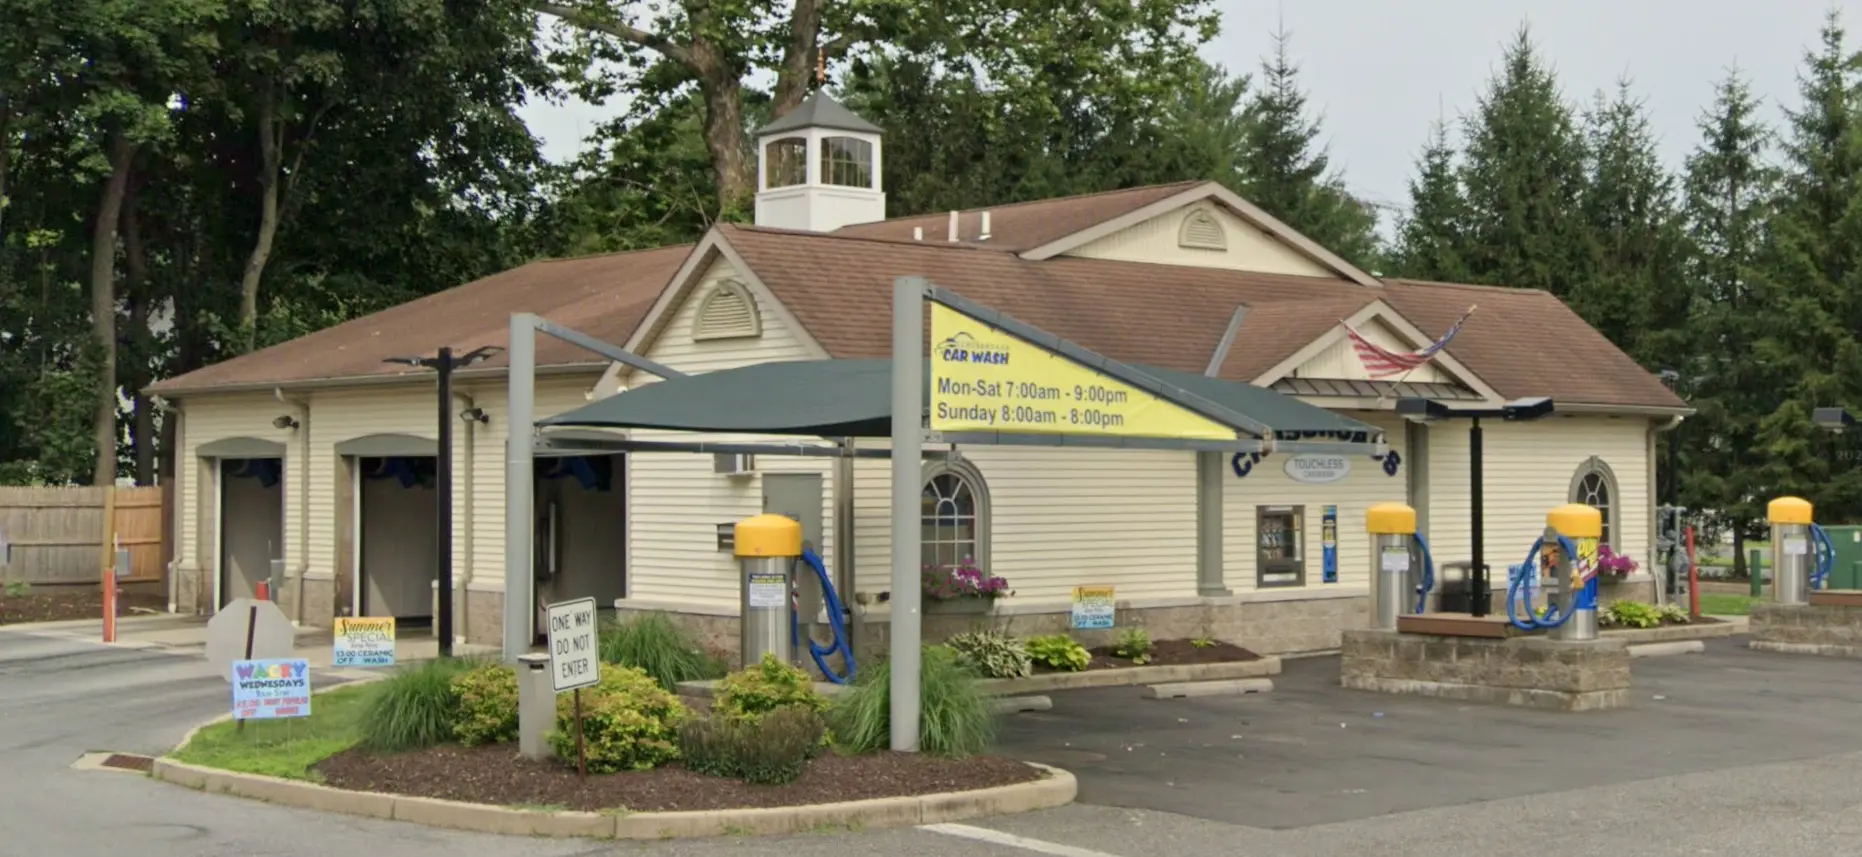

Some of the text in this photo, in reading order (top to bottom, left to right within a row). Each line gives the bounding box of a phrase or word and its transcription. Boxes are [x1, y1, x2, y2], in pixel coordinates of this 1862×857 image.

[943, 348, 1009, 365] CAR WASH
[938, 376, 1001, 397] Mon-Sat
[1006, 381, 1060, 399] 7:00am
[1074, 385, 1127, 406] 9:00pm
[938, 402, 997, 425] Sunday
[1002, 405, 1056, 423] 8:00am
[1071, 408, 1123, 428] 8:00pm
[1294, 459, 1344, 469] TOUCHLESS
[552, 610, 591, 632] ONE WAY
[347, 632, 392, 642] SPECIAL
[557, 634, 589, 655] DO NOT
[236, 662, 306, 680] WACKY
[562, 658, 588, 678] ENTER
[240, 679, 304, 690] WEDNESDAYS
